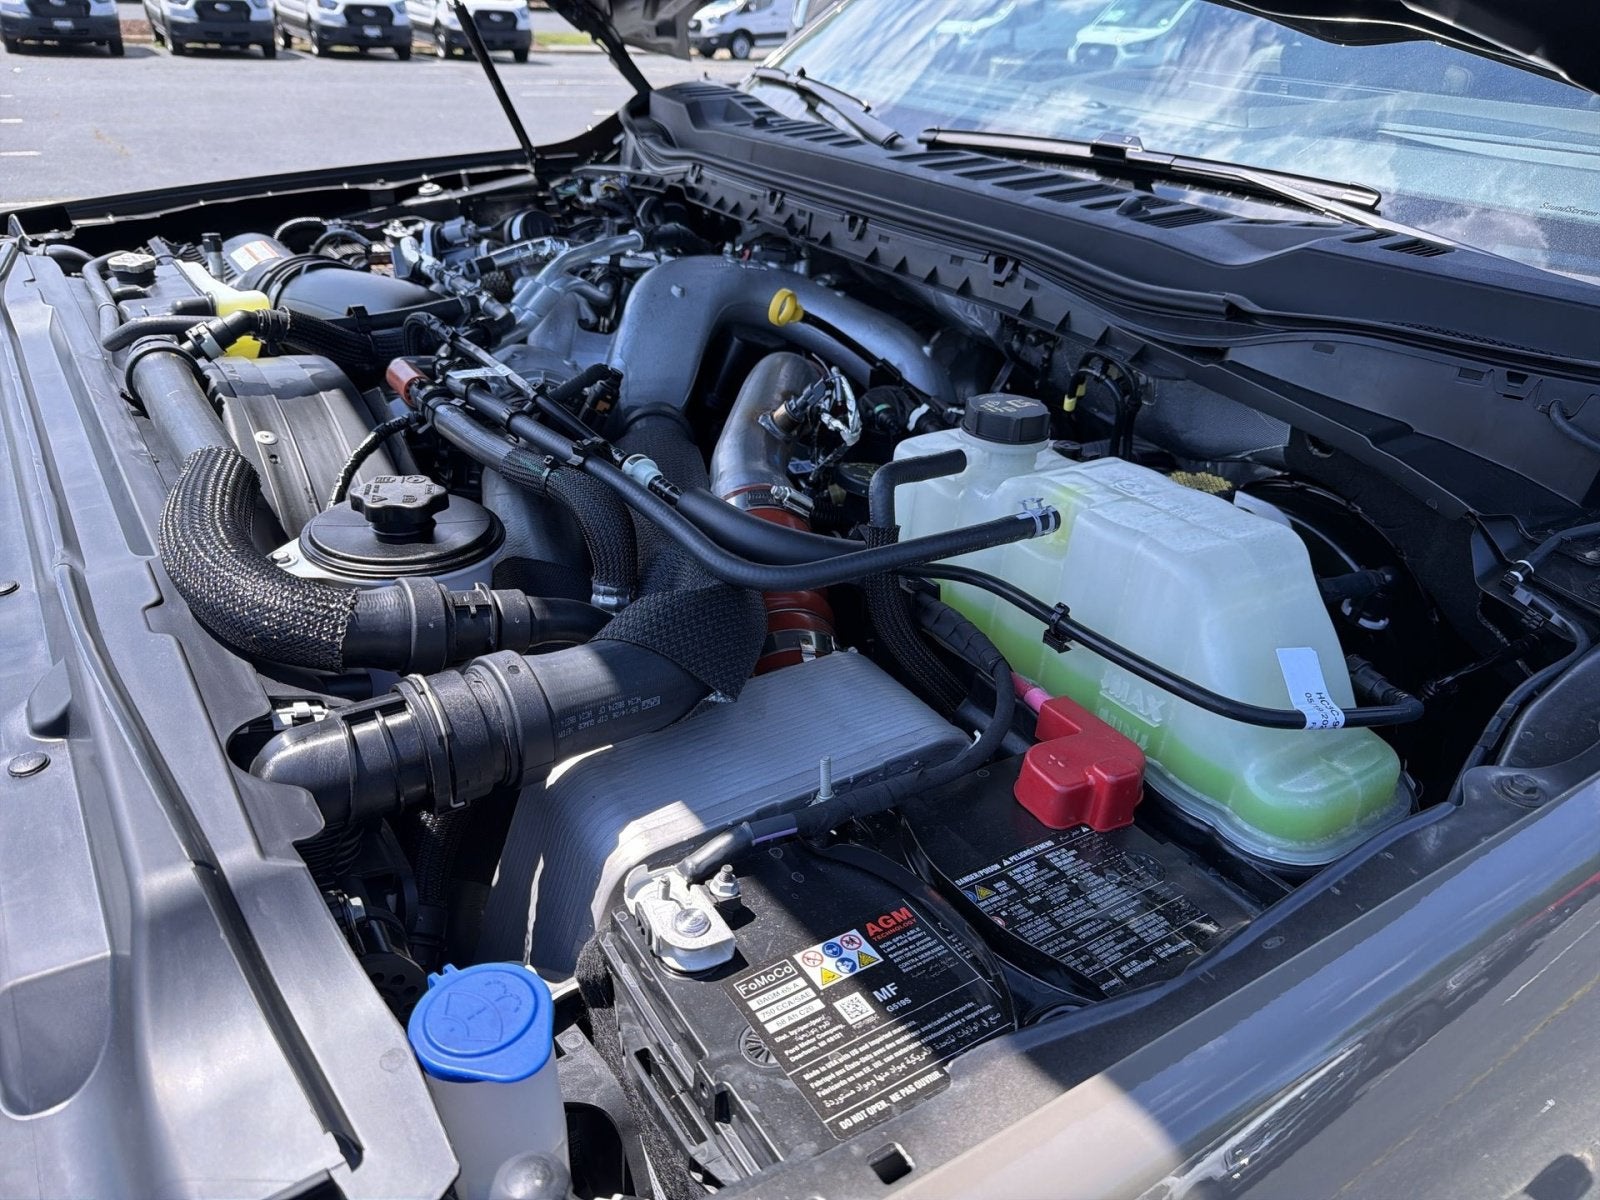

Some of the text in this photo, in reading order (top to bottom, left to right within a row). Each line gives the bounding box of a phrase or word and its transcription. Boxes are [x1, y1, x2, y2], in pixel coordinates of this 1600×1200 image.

[865, 907, 913, 937] AGM
[872, 917, 917, 942] TECHNOLOGY
[738, 965, 792, 995] FoMoCo
[873, 982, 898, 1002] MF
[756, 982, 799, 1005] BAGM-65-A
[761, 990, 811, 1018] 750 CCA/SAE
[786, 1012, 799, 1021] Ah
[798, 1005, 815, 1016] C20
[784, 1046, 800, 1056] Ford
[798, 1036, 817, 1048] Motor
[825, 1059, 839, 1068] USA
[839, 1117, 855, 1129] DO
[851, 1110, 869, 1123] NOT
[866, 1098, 890, 1114] OPEN.
[889, 1091, 903, 1102] NE
[900, 1083, 917, 1096] PAS
[913, 1068, 944, 1089] OUVRIR.
